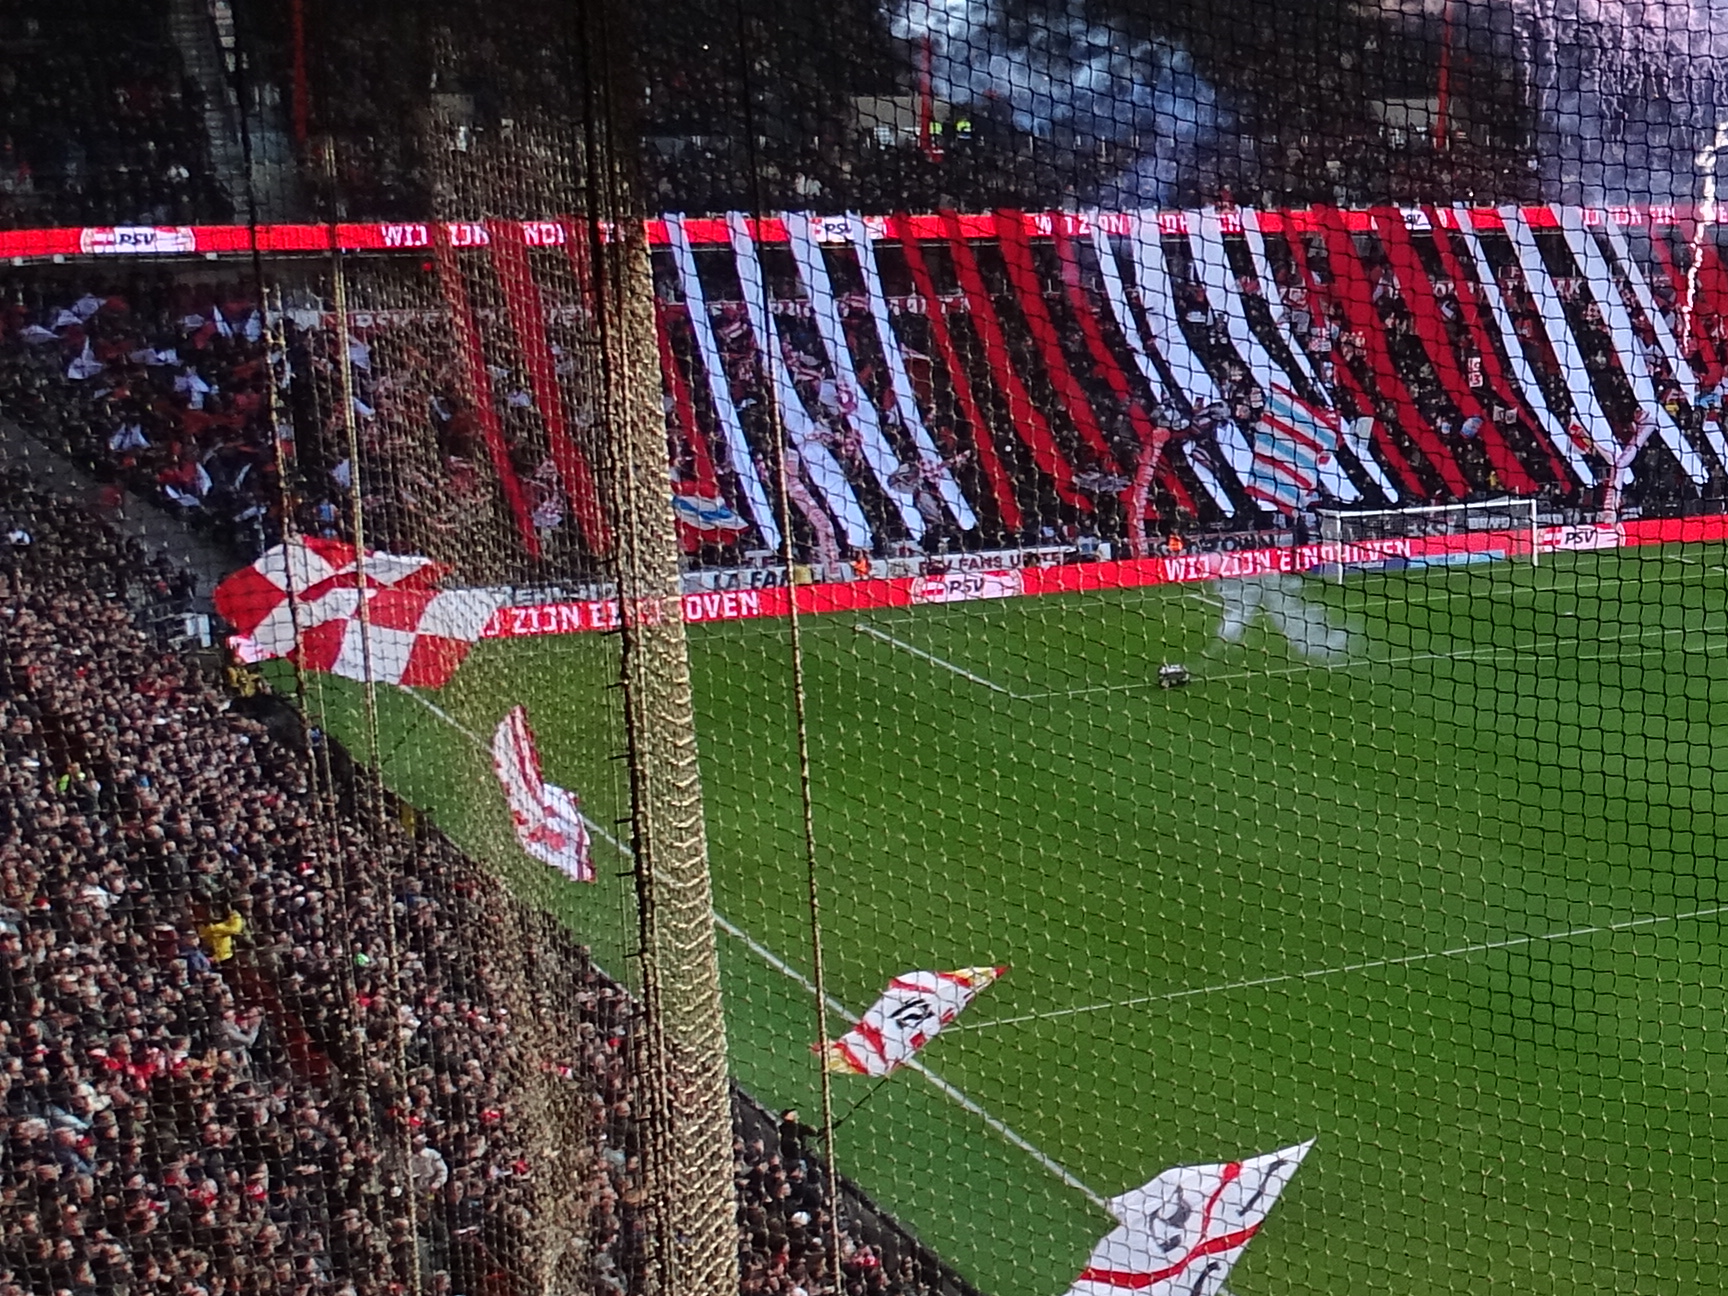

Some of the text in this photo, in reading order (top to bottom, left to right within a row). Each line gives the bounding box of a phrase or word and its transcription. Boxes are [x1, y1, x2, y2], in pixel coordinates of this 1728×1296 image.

[1565, 528, 1596, 545] PSV
[1165, 554, 1210, 582] WIJ
[1219, 549, 1271, 577] ZIJN
[949, 578, 985, 595] PSV
